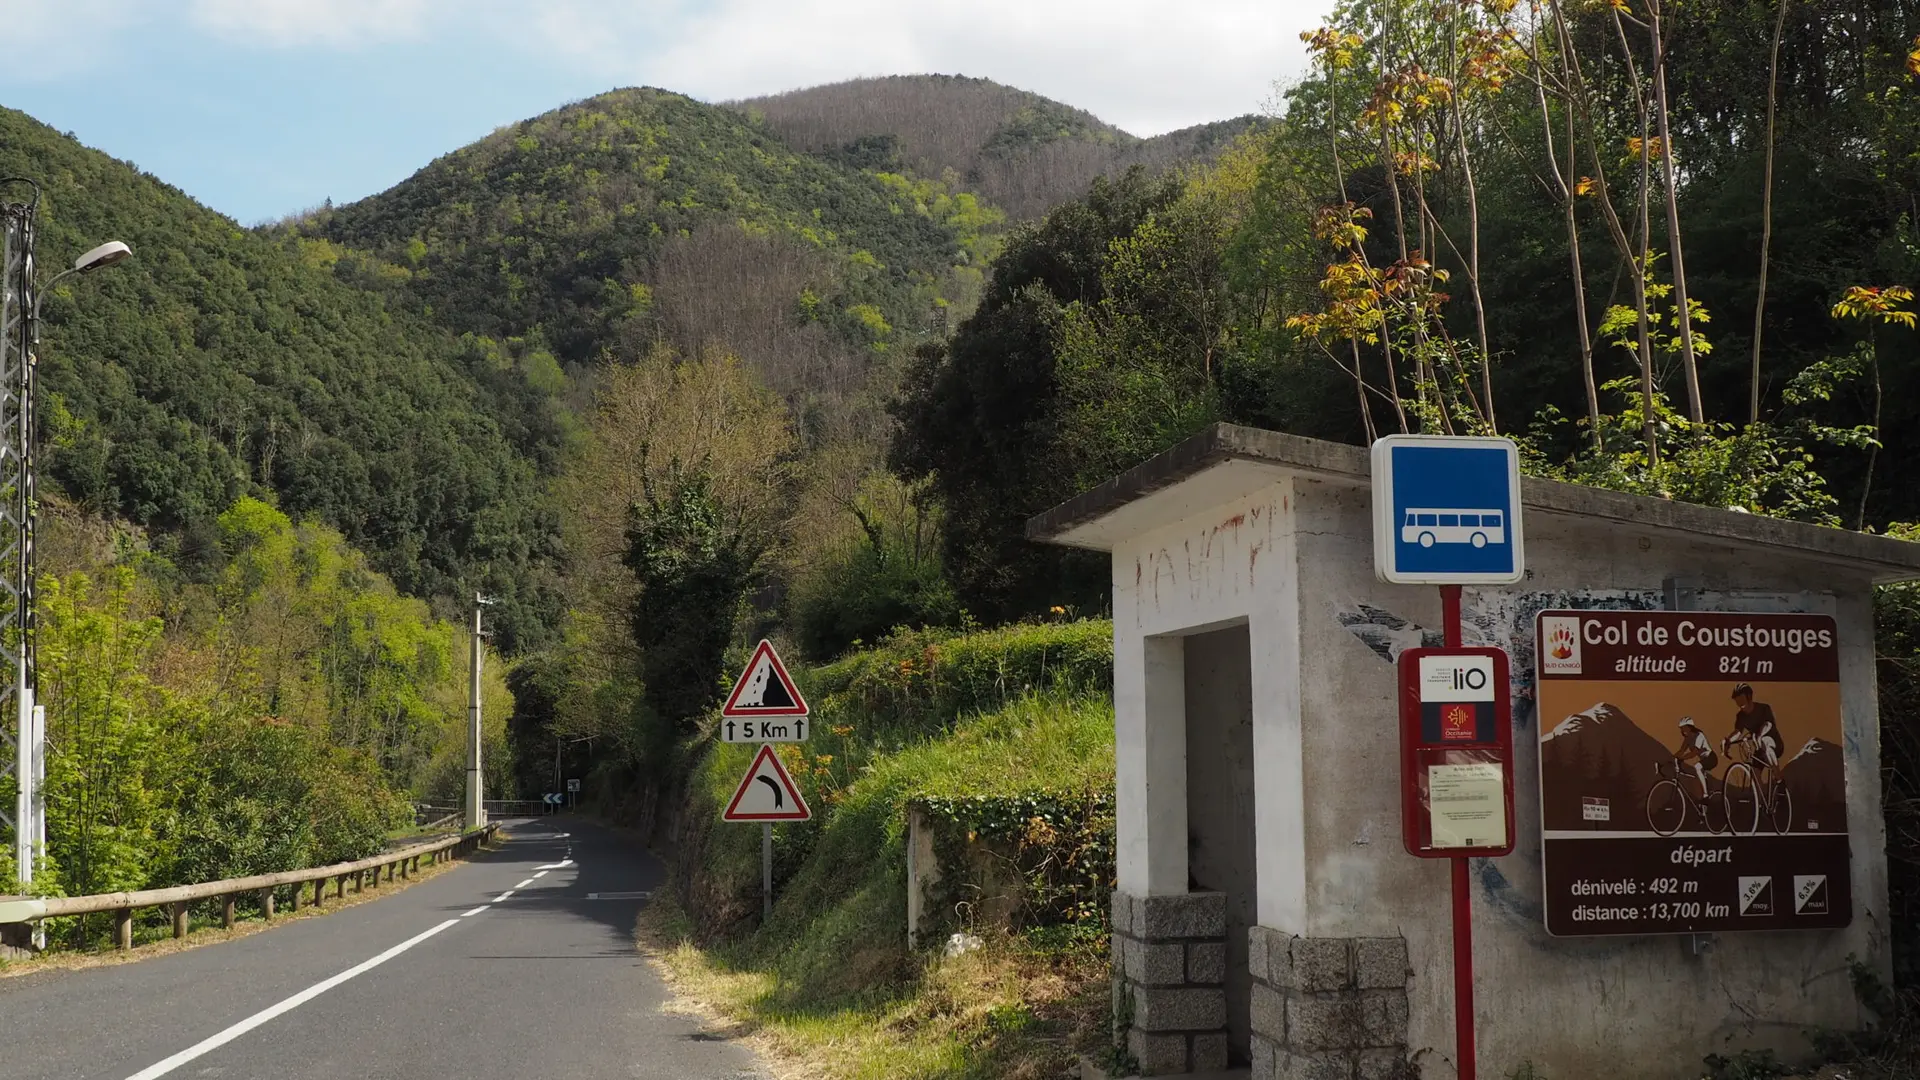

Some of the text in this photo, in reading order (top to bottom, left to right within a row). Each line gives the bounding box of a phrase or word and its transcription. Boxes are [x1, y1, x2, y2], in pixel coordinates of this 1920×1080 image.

[1583, 619, 1832, 654] Col de Coustouges
[1615, 655, 1773, 674] altitude 821 m
[743, 721, 788, 738] 5 Km
[1670, 845, 1733, 867] départ
[1571, 878, 1637, 896] dénivelé
[1649, 877, 1678, 894] 492
[1682, 880, 1698, 893] m
[1744, 881, 1761, 902] 3,6%
[1798, 880, 1815, 900] 6,3%
[1572, 904, 1639, 921] distance
[1705, 901, 1730, 918] km
[1752, 903, 1769, 911] moy.
